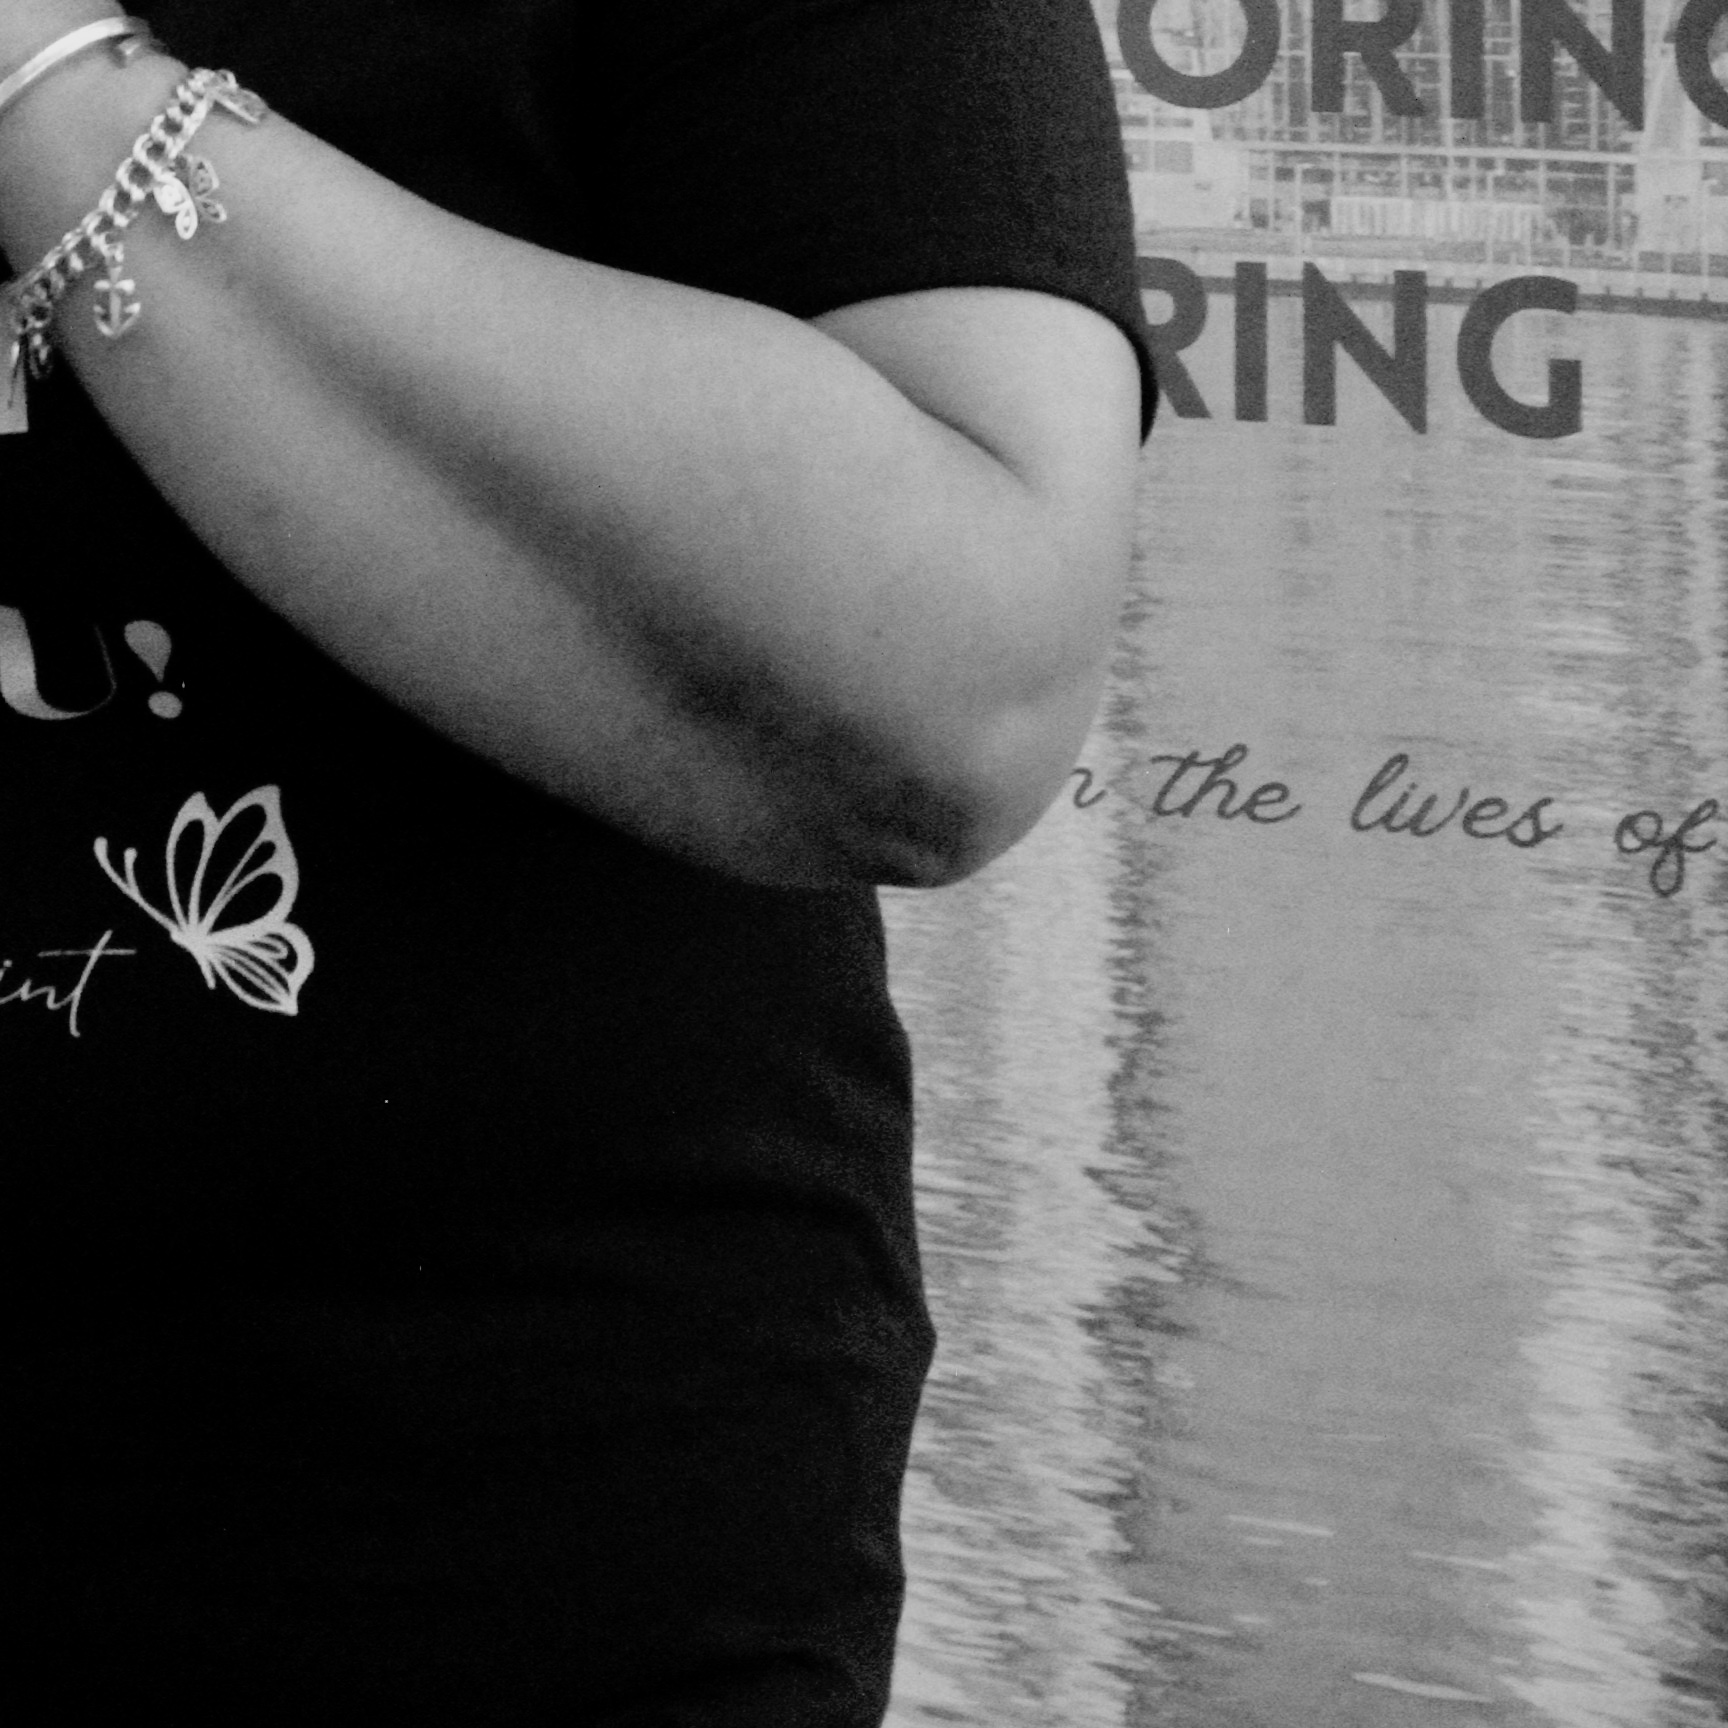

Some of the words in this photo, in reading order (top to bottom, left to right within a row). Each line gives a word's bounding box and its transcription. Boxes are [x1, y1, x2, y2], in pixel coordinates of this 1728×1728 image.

[1150, 743, 1302, 824] the
[1350, 753, 1565, 847] lives
[1614, 799, 1721, 898] of
